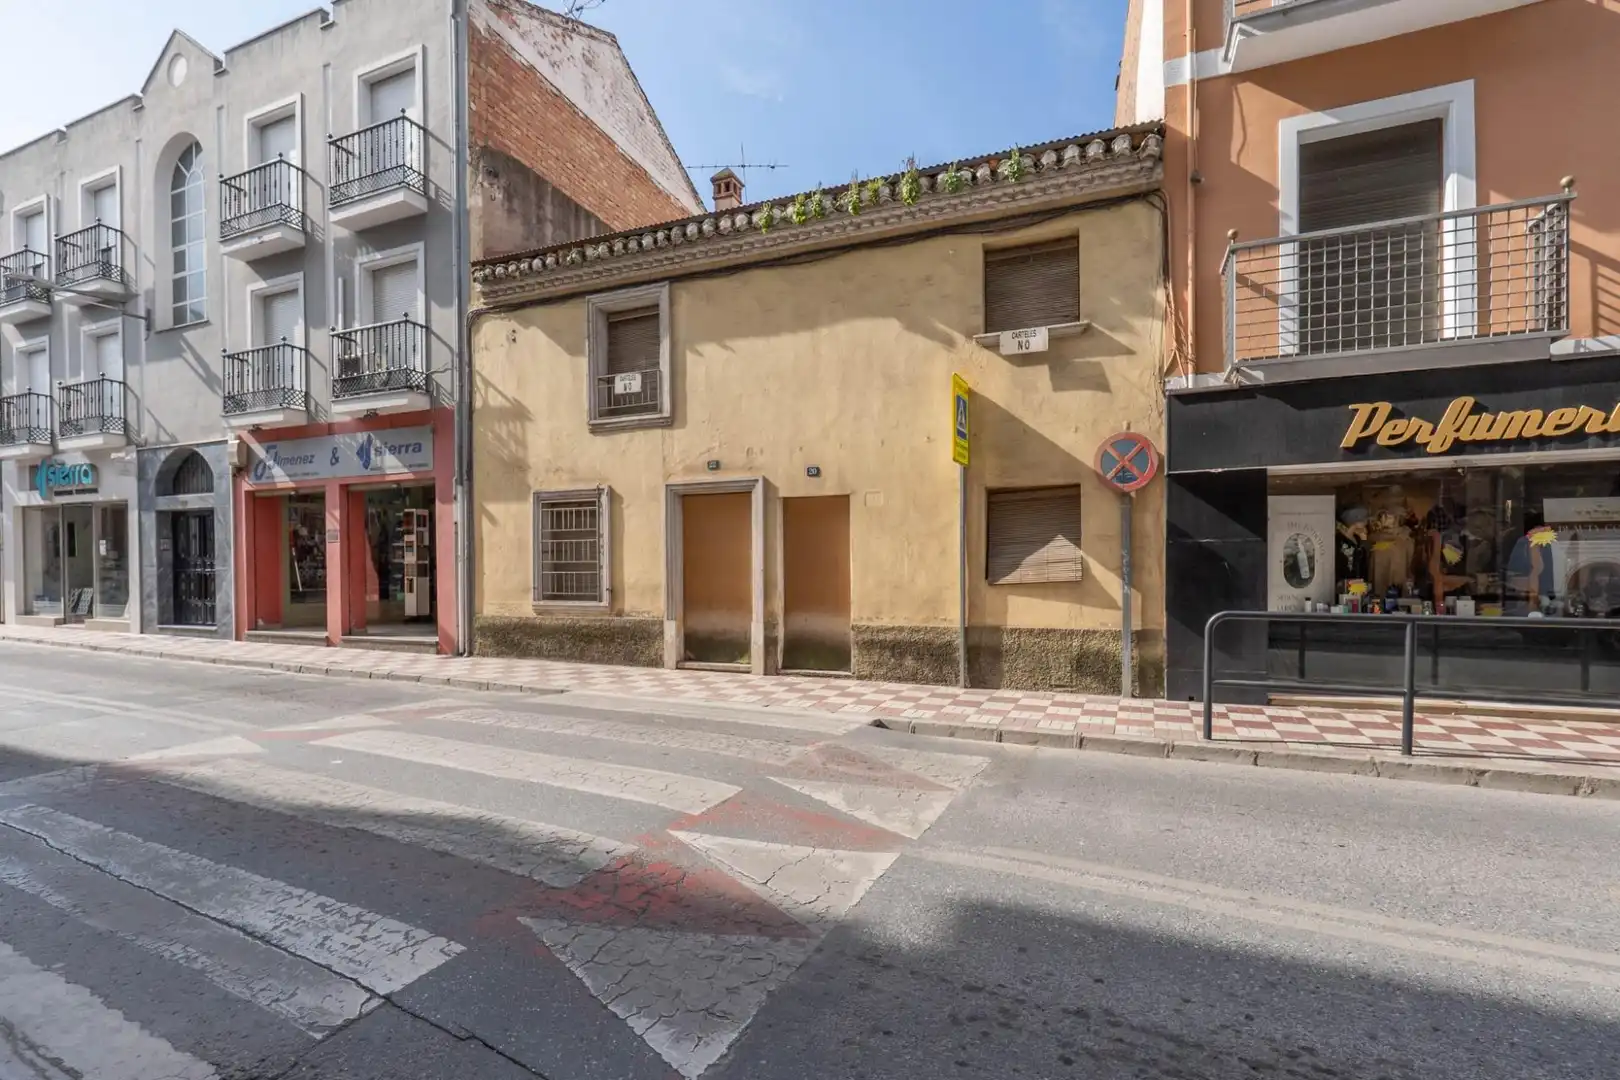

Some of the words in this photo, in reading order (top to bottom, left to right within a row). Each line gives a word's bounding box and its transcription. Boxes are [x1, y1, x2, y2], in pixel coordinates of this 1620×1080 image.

[1011, 329, 1037, 340] CARTELES
[1017, 340, 1031, 351] NO
[329, 446, 340, 466] &
